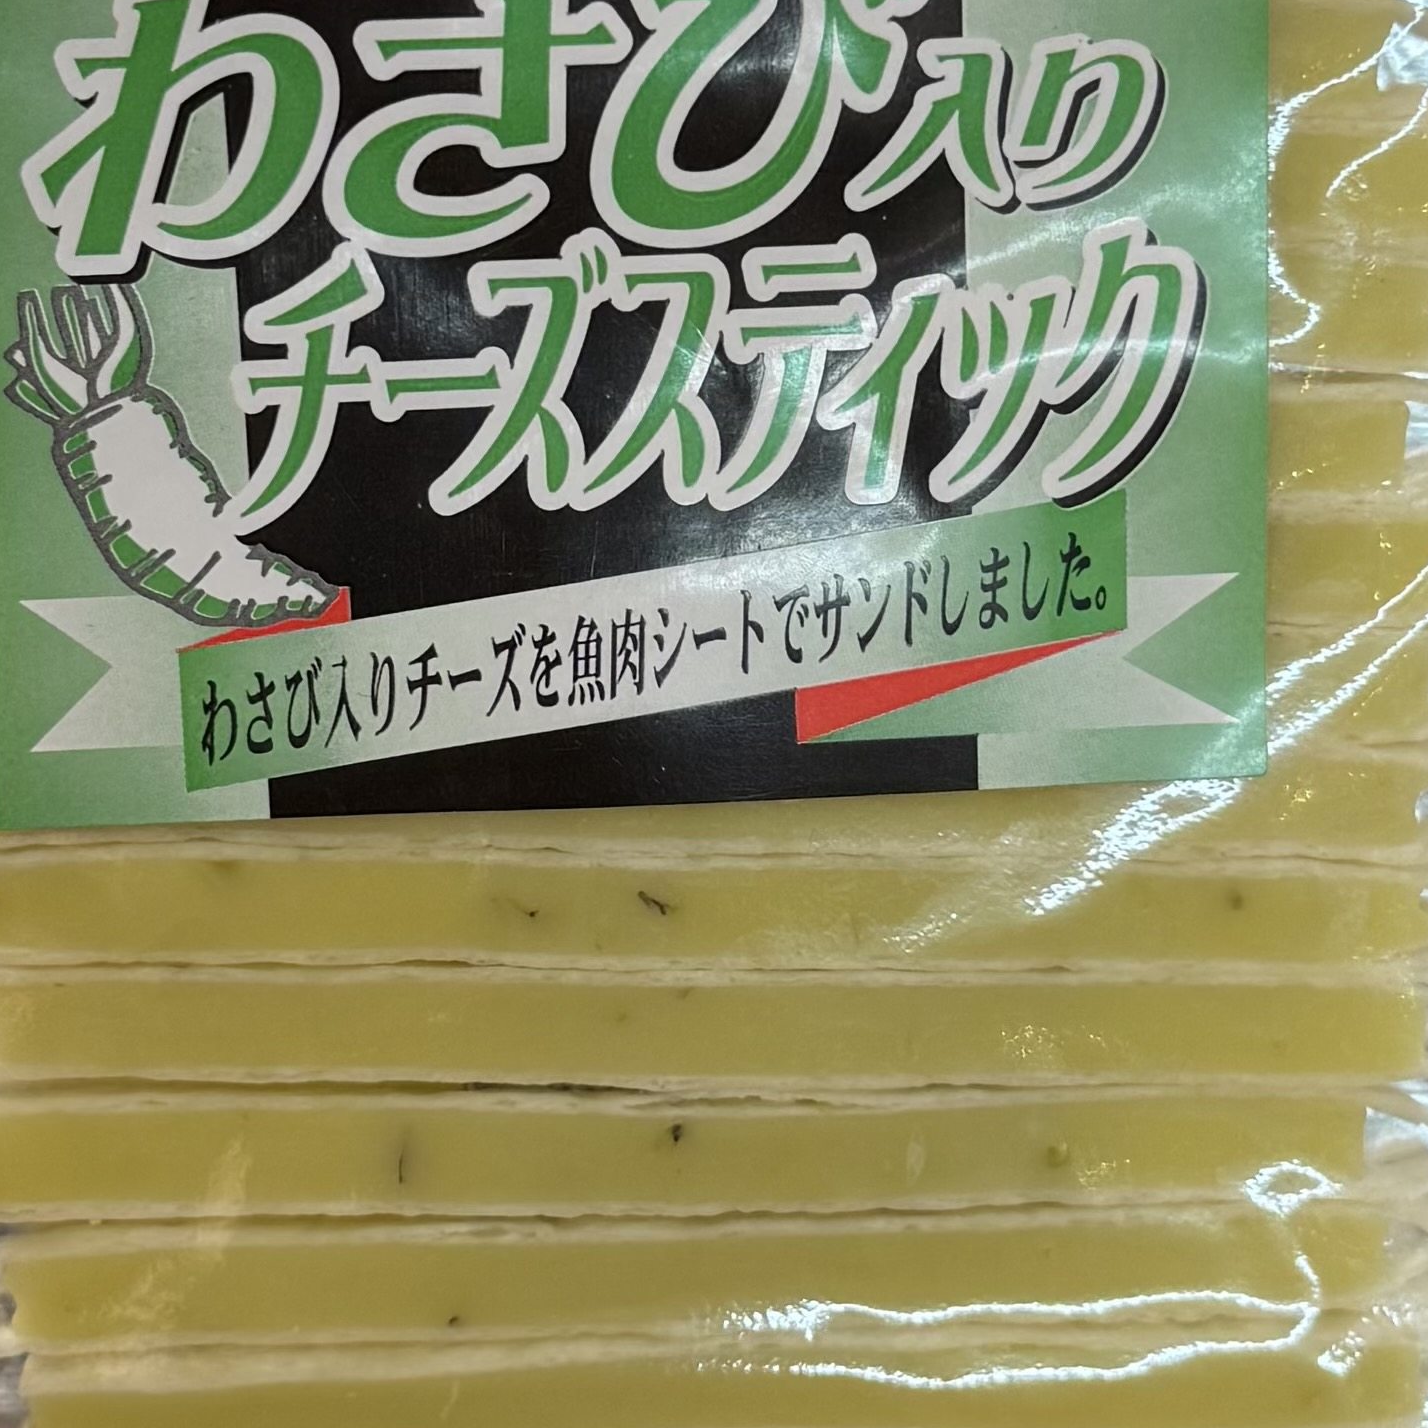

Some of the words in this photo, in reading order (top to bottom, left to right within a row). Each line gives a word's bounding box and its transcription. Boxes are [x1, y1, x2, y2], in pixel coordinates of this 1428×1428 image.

[225, 218, 1208, 530] チーズスティック
[199, 530, 1118, 766] わさび入りチーズを魚肉シートでサンドしました。
